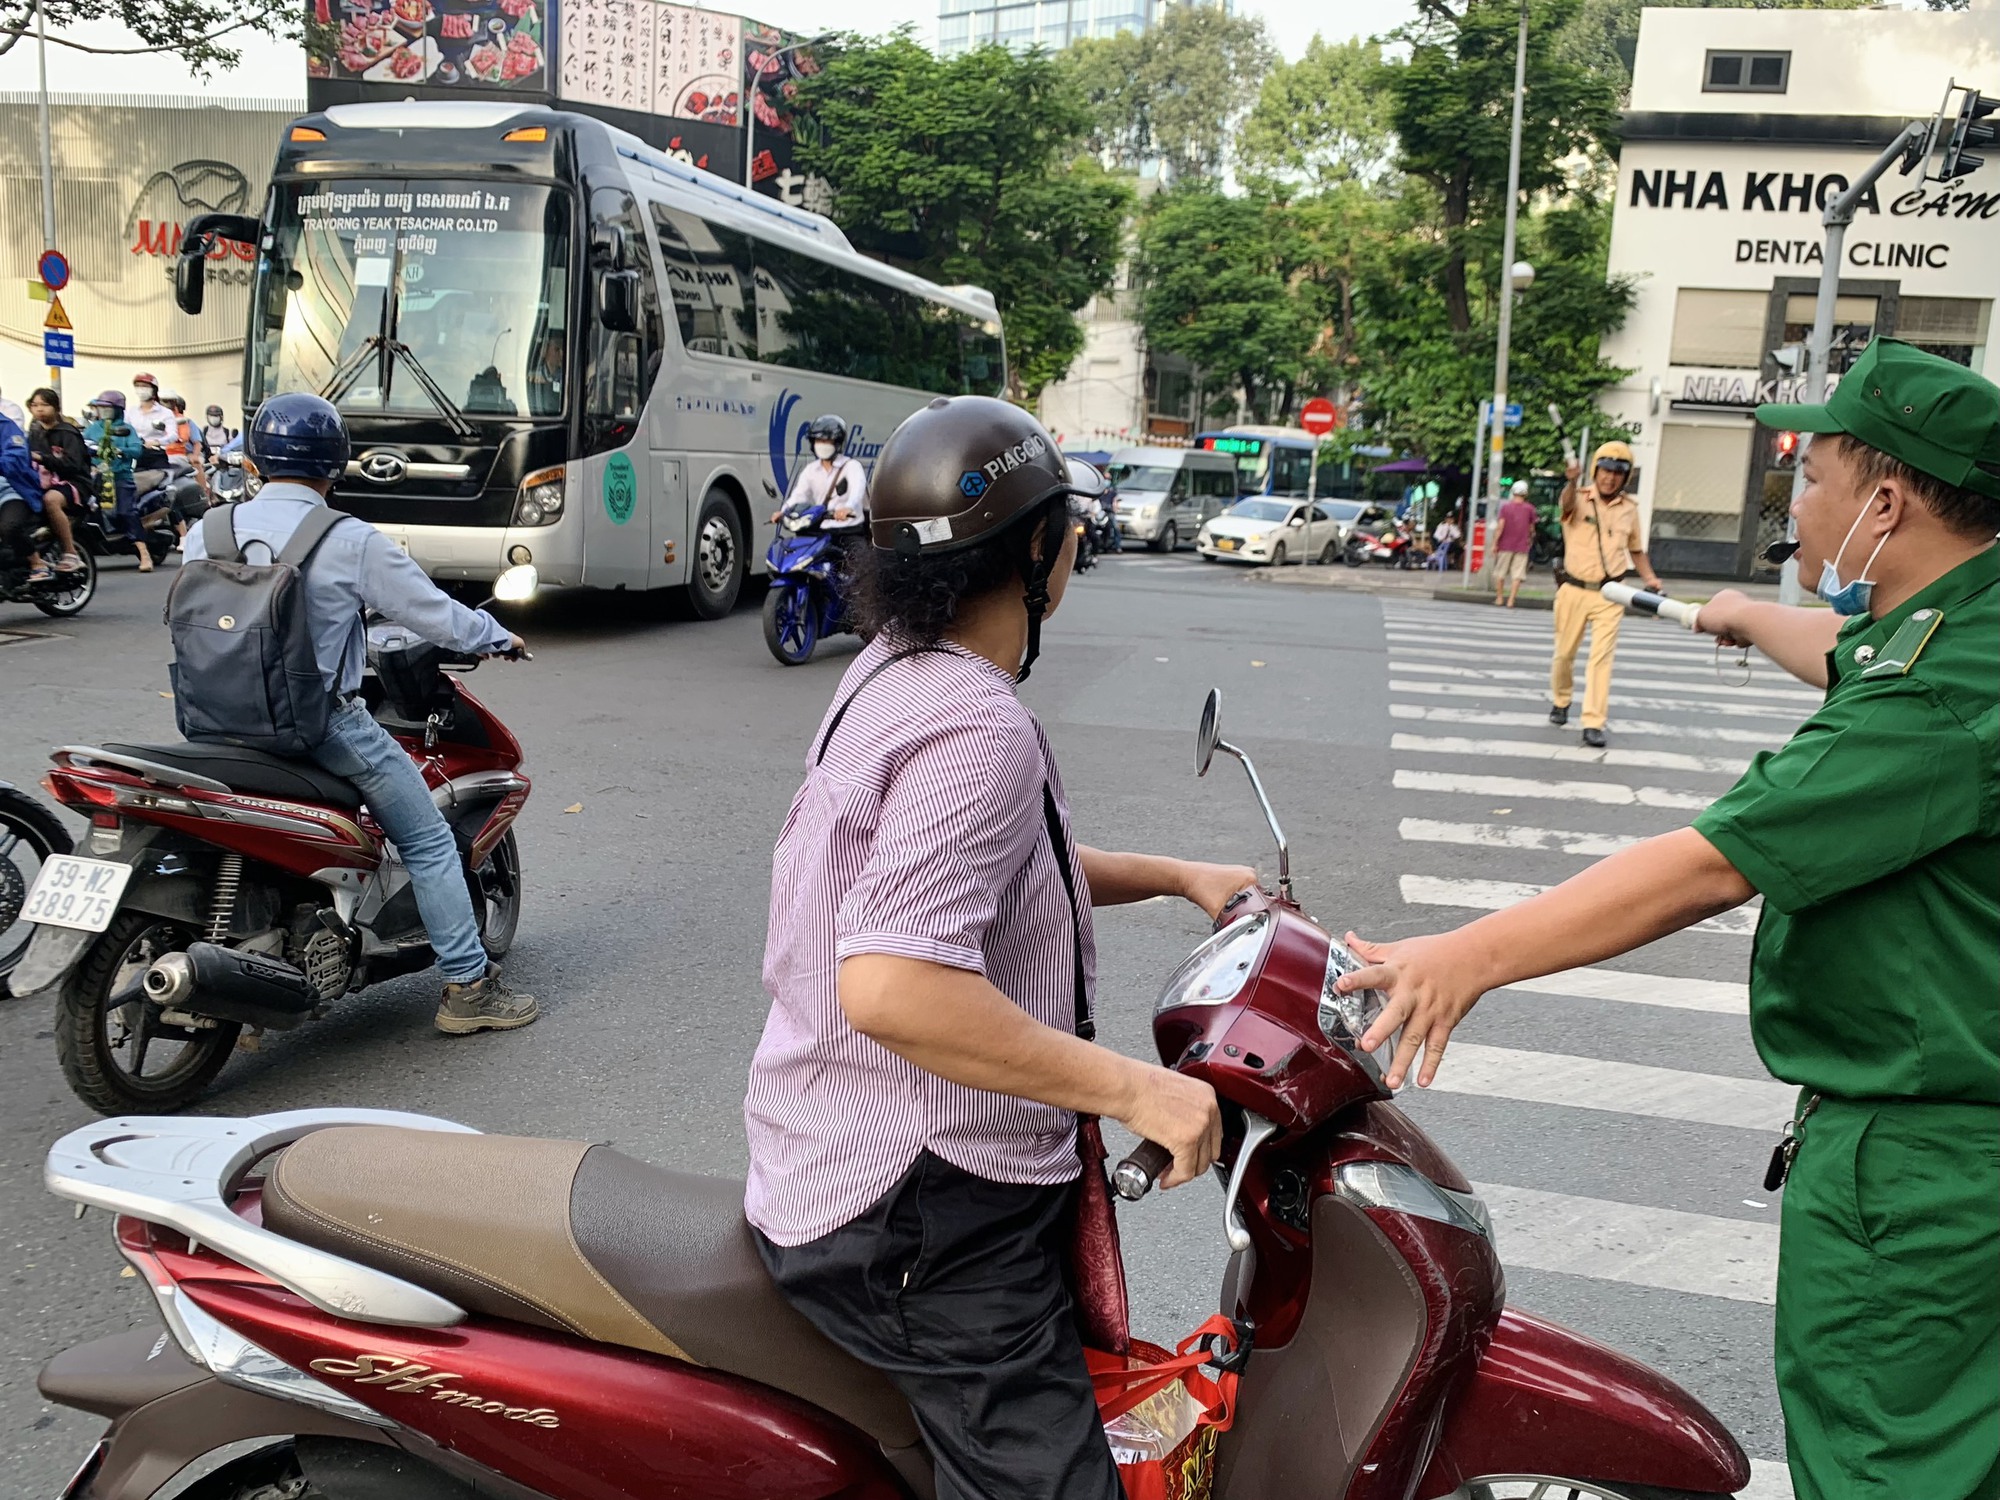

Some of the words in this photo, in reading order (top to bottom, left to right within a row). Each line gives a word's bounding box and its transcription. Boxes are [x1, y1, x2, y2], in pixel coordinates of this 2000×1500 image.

[1630, 169, 1728, 210] NHA
[303, 217, 360, 231] TRAYORNG
[362, 217, 392, 230] YEAK
[395, 217, 454, 231] TESACHAR
[456, 218, 498, 233] CO.LTD
[1736, 240, 1824, 264] DENTA
[1849, 242, 1950, 268] CLINIC
[405, 266, 420, 279] KH
[1684, 376, 1746, 402] NHA
[1755, 379, 1836, 403] KH
[984, 433, 1047, 481] PIAGGIO
